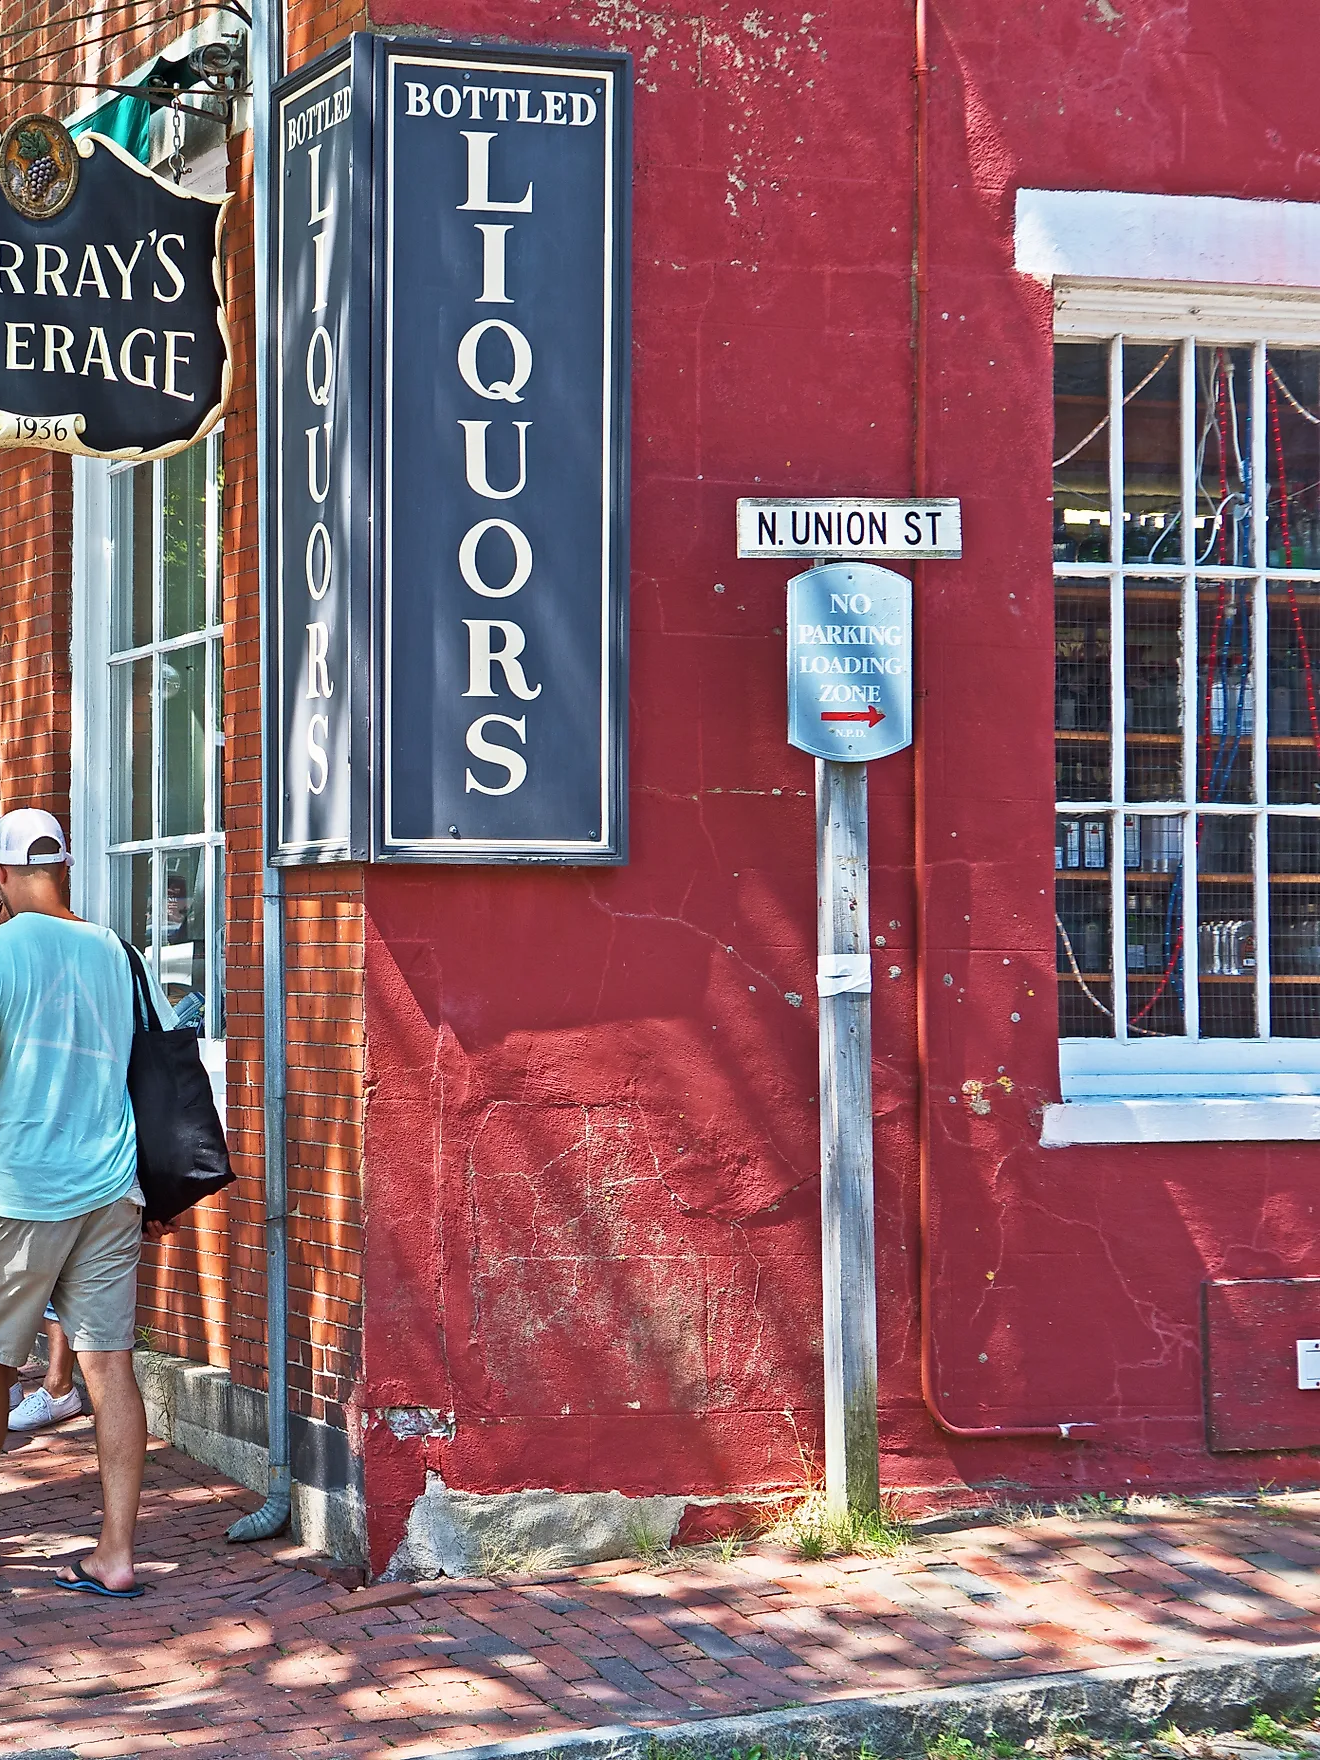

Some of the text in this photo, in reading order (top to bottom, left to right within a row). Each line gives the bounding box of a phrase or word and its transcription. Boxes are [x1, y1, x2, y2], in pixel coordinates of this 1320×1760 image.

[287, 85, 352, 152] BOTTLED
[404, 81, 598, 127] BOTTLED
[14, 417, 68, 442] 1936
[306, 144, 335, 795] LIQUORS
[456, 130, 542, 796] LIQUORS
[903, 511, 942, 546] ST
[829, 593, 872, 615] NO
[797, 624, 903, 646] PARKING
[799, 655, 903, 675] LOADING
[818, 683, 881, 703] ZONE
